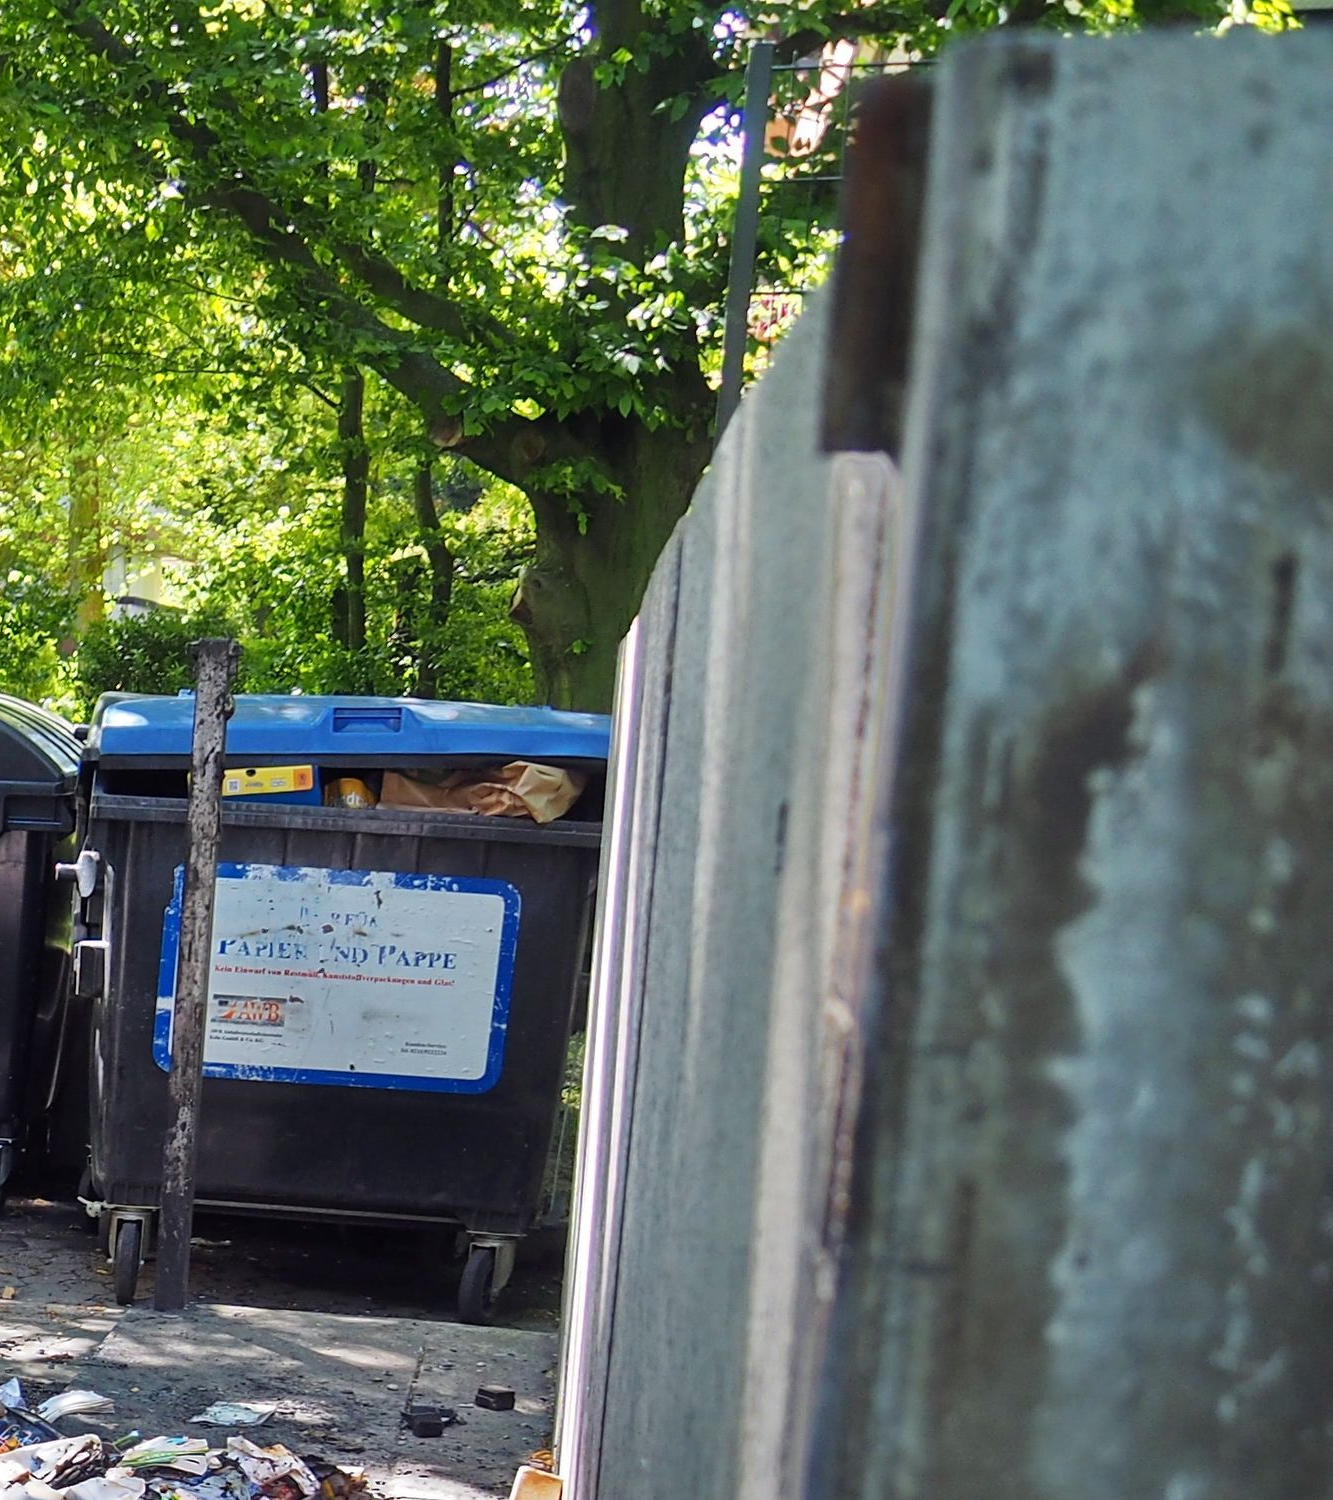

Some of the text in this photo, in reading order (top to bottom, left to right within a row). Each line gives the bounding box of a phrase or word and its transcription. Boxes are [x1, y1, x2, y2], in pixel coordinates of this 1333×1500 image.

[378, 944, 457, 970] PAPPE
[234, 965, 266, 976] Einwurf
[267, 968, 282, 976] von
[417, 976, 432, 986] und
[237, 1000, 280, 1023] AWB
